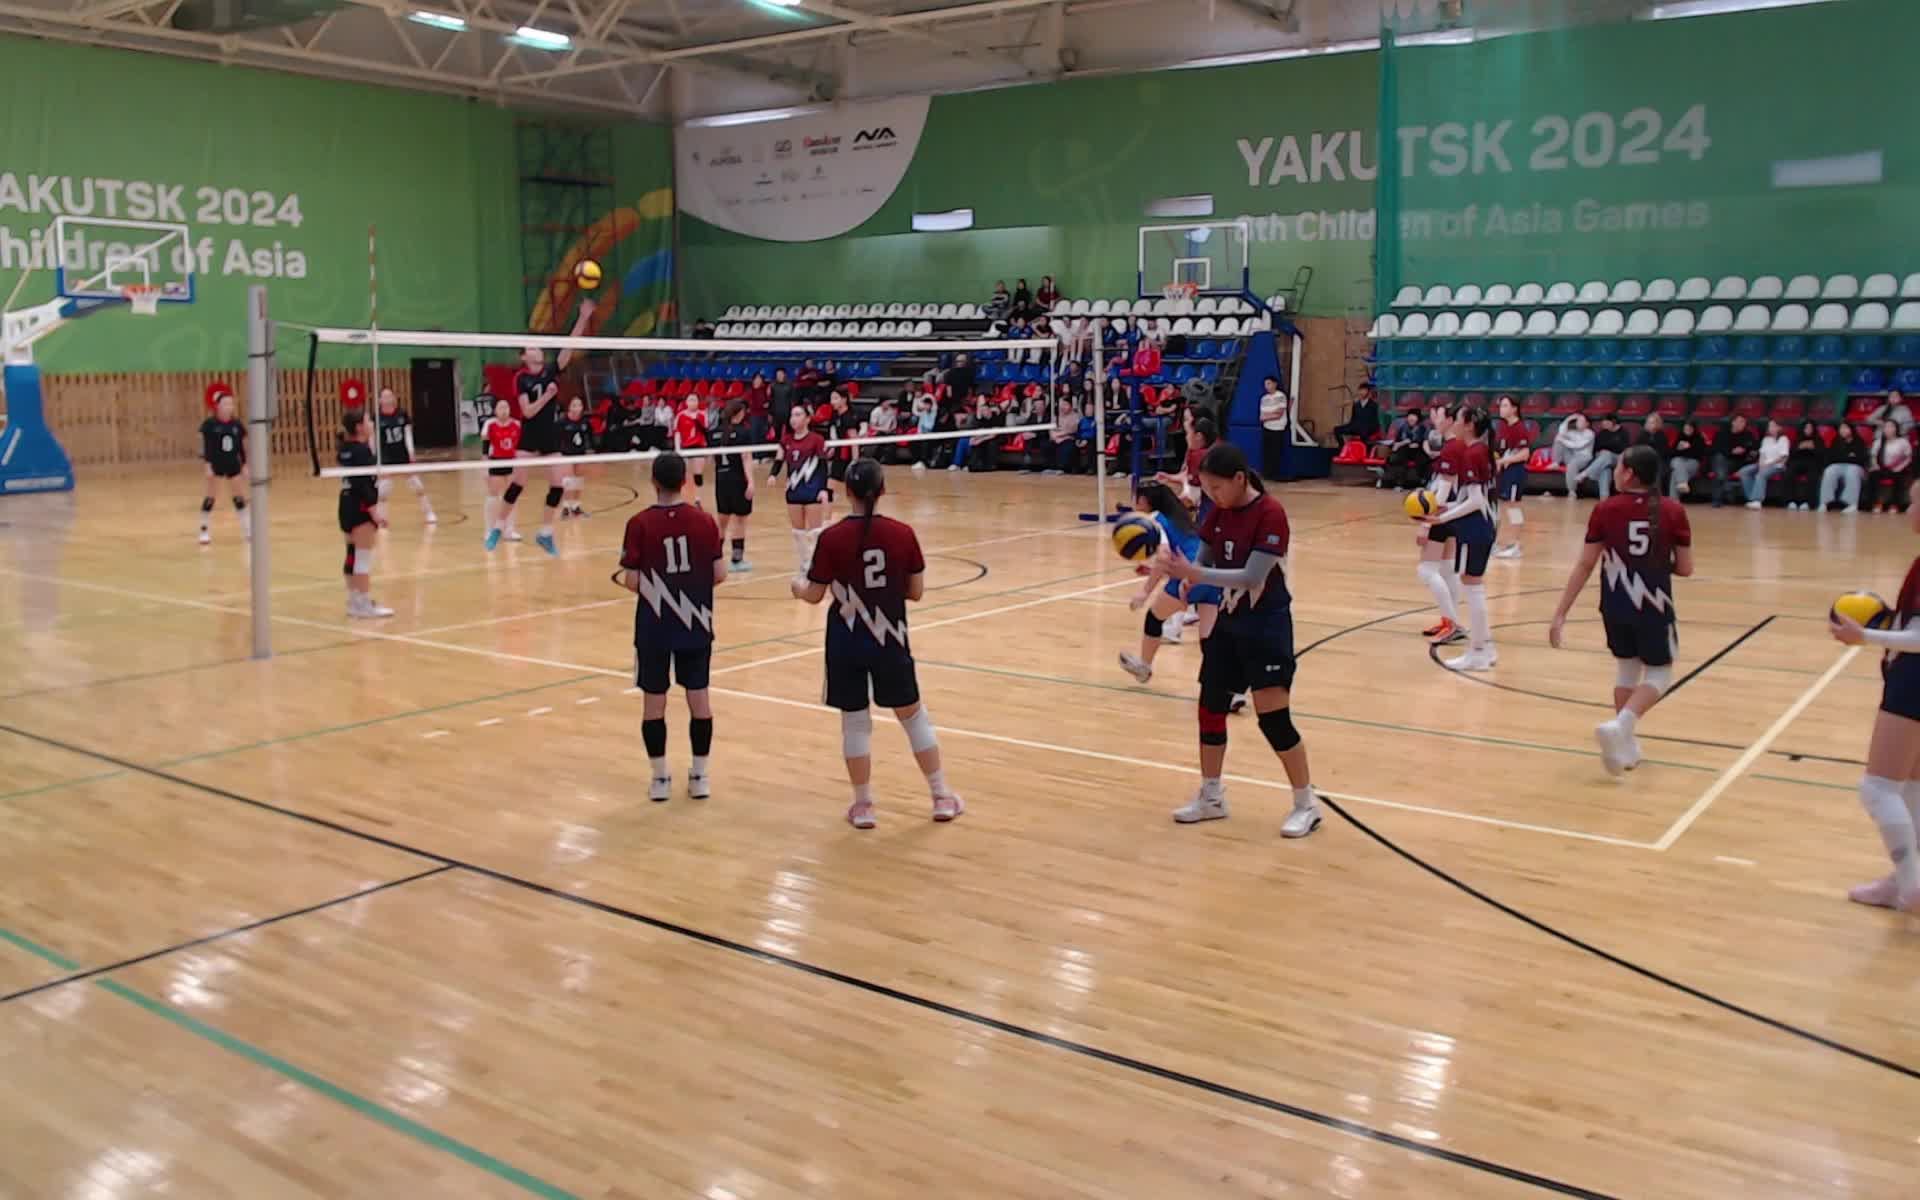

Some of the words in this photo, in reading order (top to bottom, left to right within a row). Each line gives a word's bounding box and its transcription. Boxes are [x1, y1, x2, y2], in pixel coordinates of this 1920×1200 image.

[1530, 103, 1712, 170] 2024
[0, 173, 185, 222] AKUTSK
[195, 186, 303, 227] 2024
[1441, 202, 1478, 238] of
[1485, 201, 1562, 237] Asia
[1574, 198, 1708, 232] Games
[0, 226, 160, 273] hildren
[171, 237, 215, 274] of
[222, 239, 307, 278] Asia
[663, 535, 691, 574] 11
[1628, 521, 1650, 556] 5
[862, 548, 887, 589] 2
